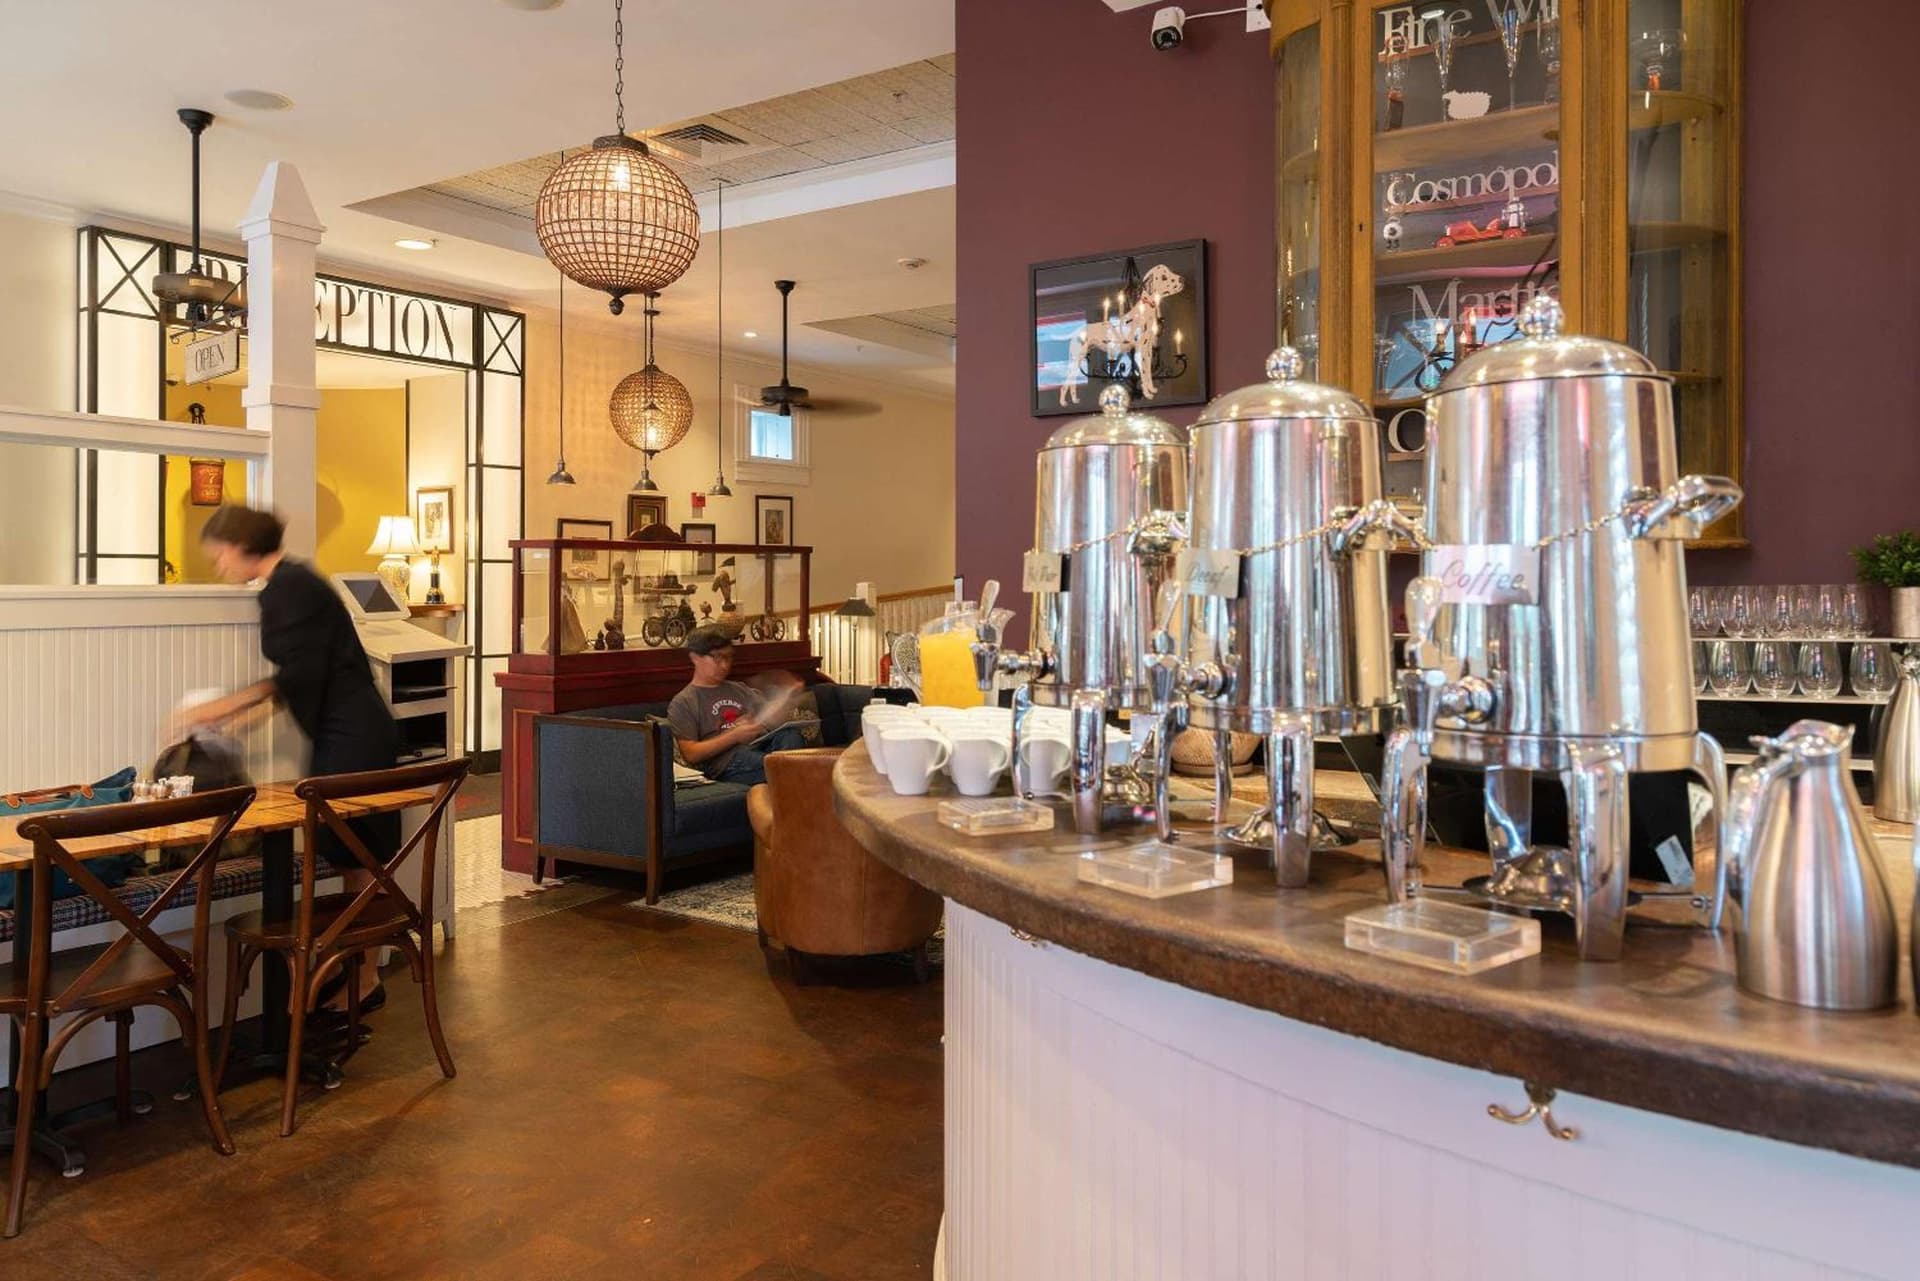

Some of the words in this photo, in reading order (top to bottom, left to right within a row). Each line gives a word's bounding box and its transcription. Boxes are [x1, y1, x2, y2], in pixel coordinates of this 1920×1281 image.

[1378, 6, 1473, 57] Fine
[1407, 277, 1559, 328] Marti
[194, 343, 225, 374] OPEN
[1441, 558, 1526, 596] Coffee
